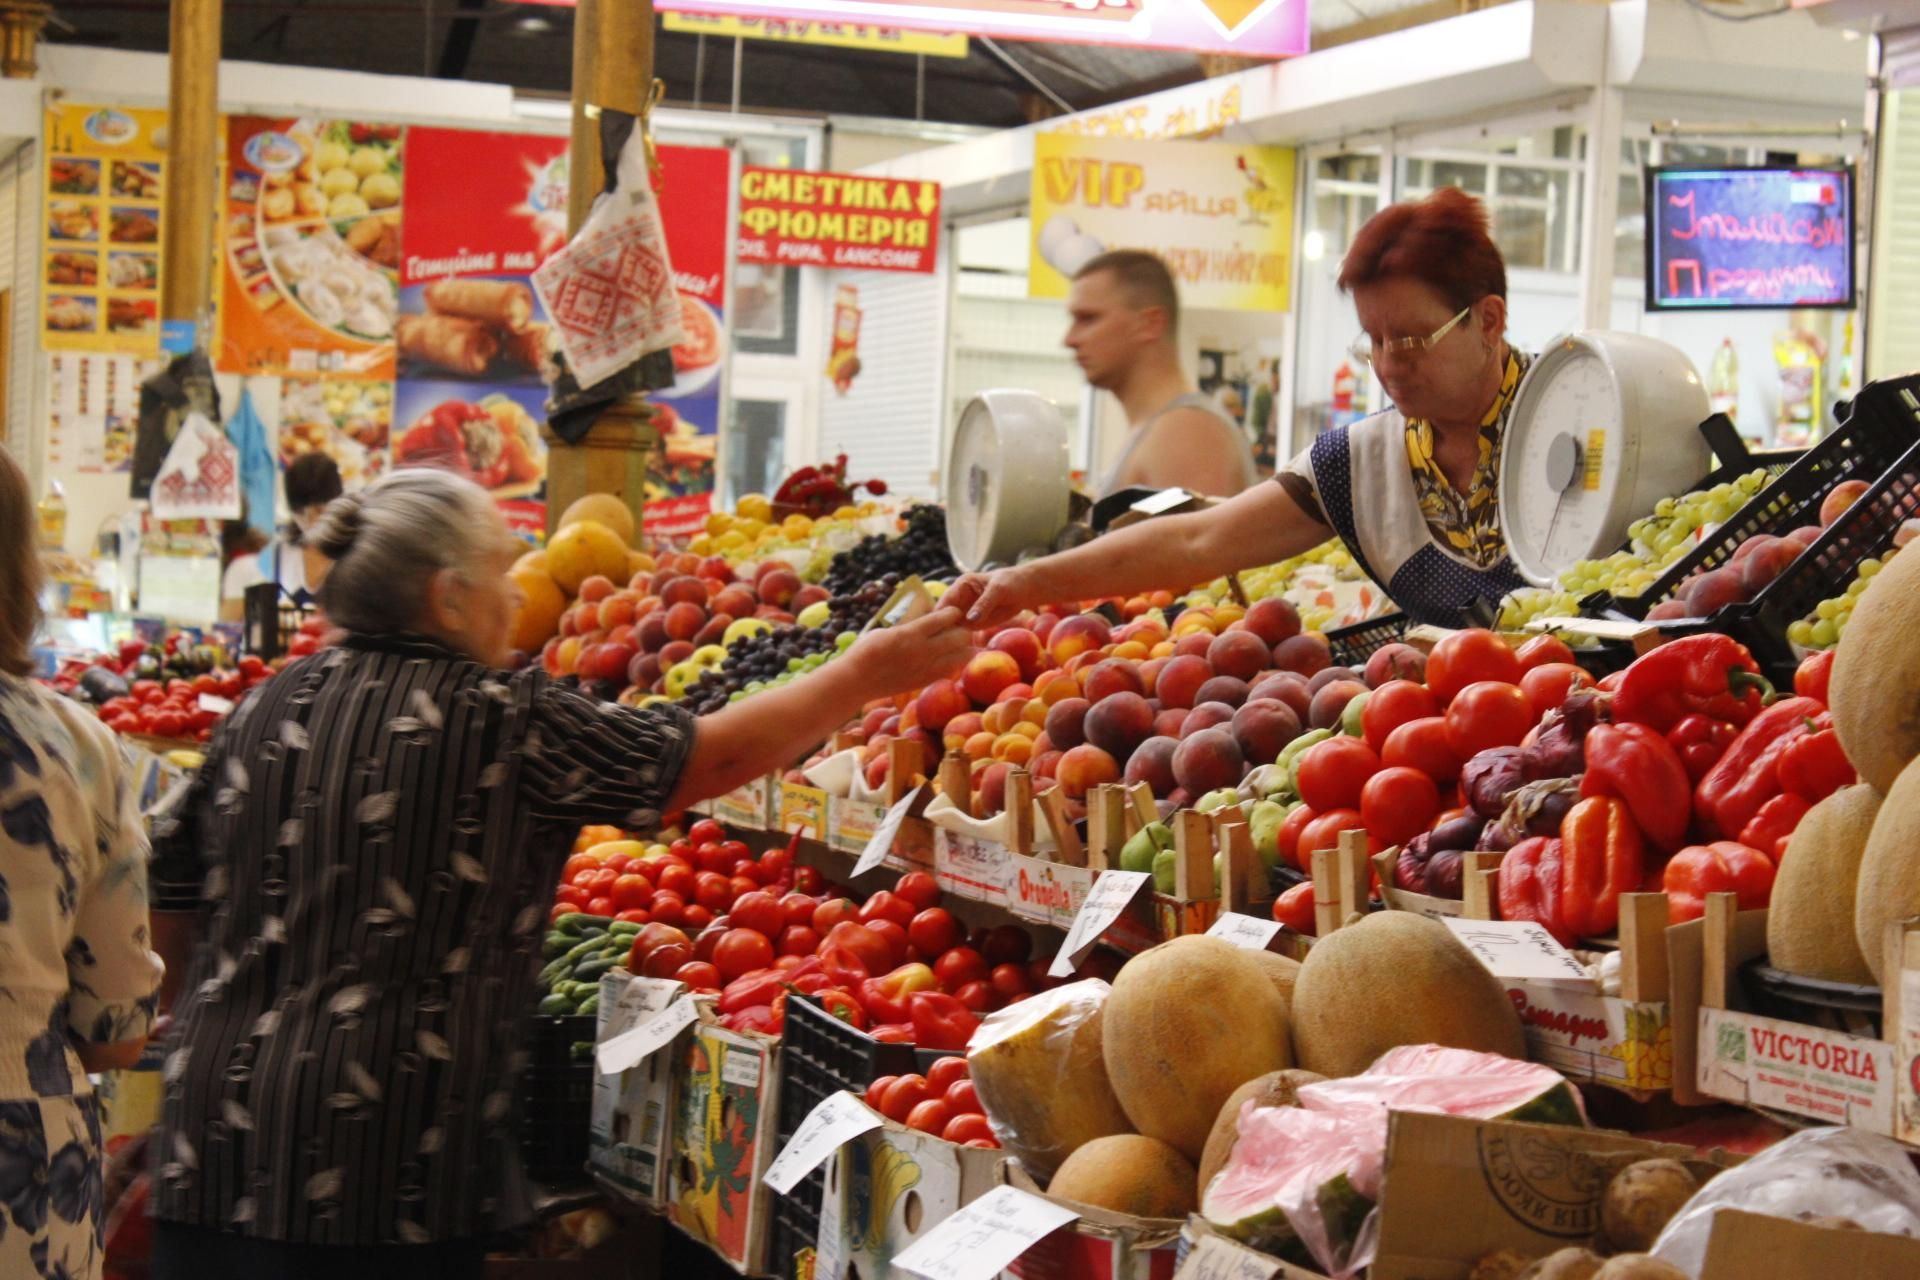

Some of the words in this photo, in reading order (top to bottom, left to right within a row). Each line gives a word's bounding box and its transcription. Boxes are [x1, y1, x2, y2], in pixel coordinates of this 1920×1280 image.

[741, 171, 912, 211] СМЕТИКА
[1041, 157, 1145, 208] VIP
[739, 206, 929, 248] ФЮМЕРІЯ
[833, 246, 922, 268] LANCOME
[1751, 1027, 1879, 1082] VICTORIA
